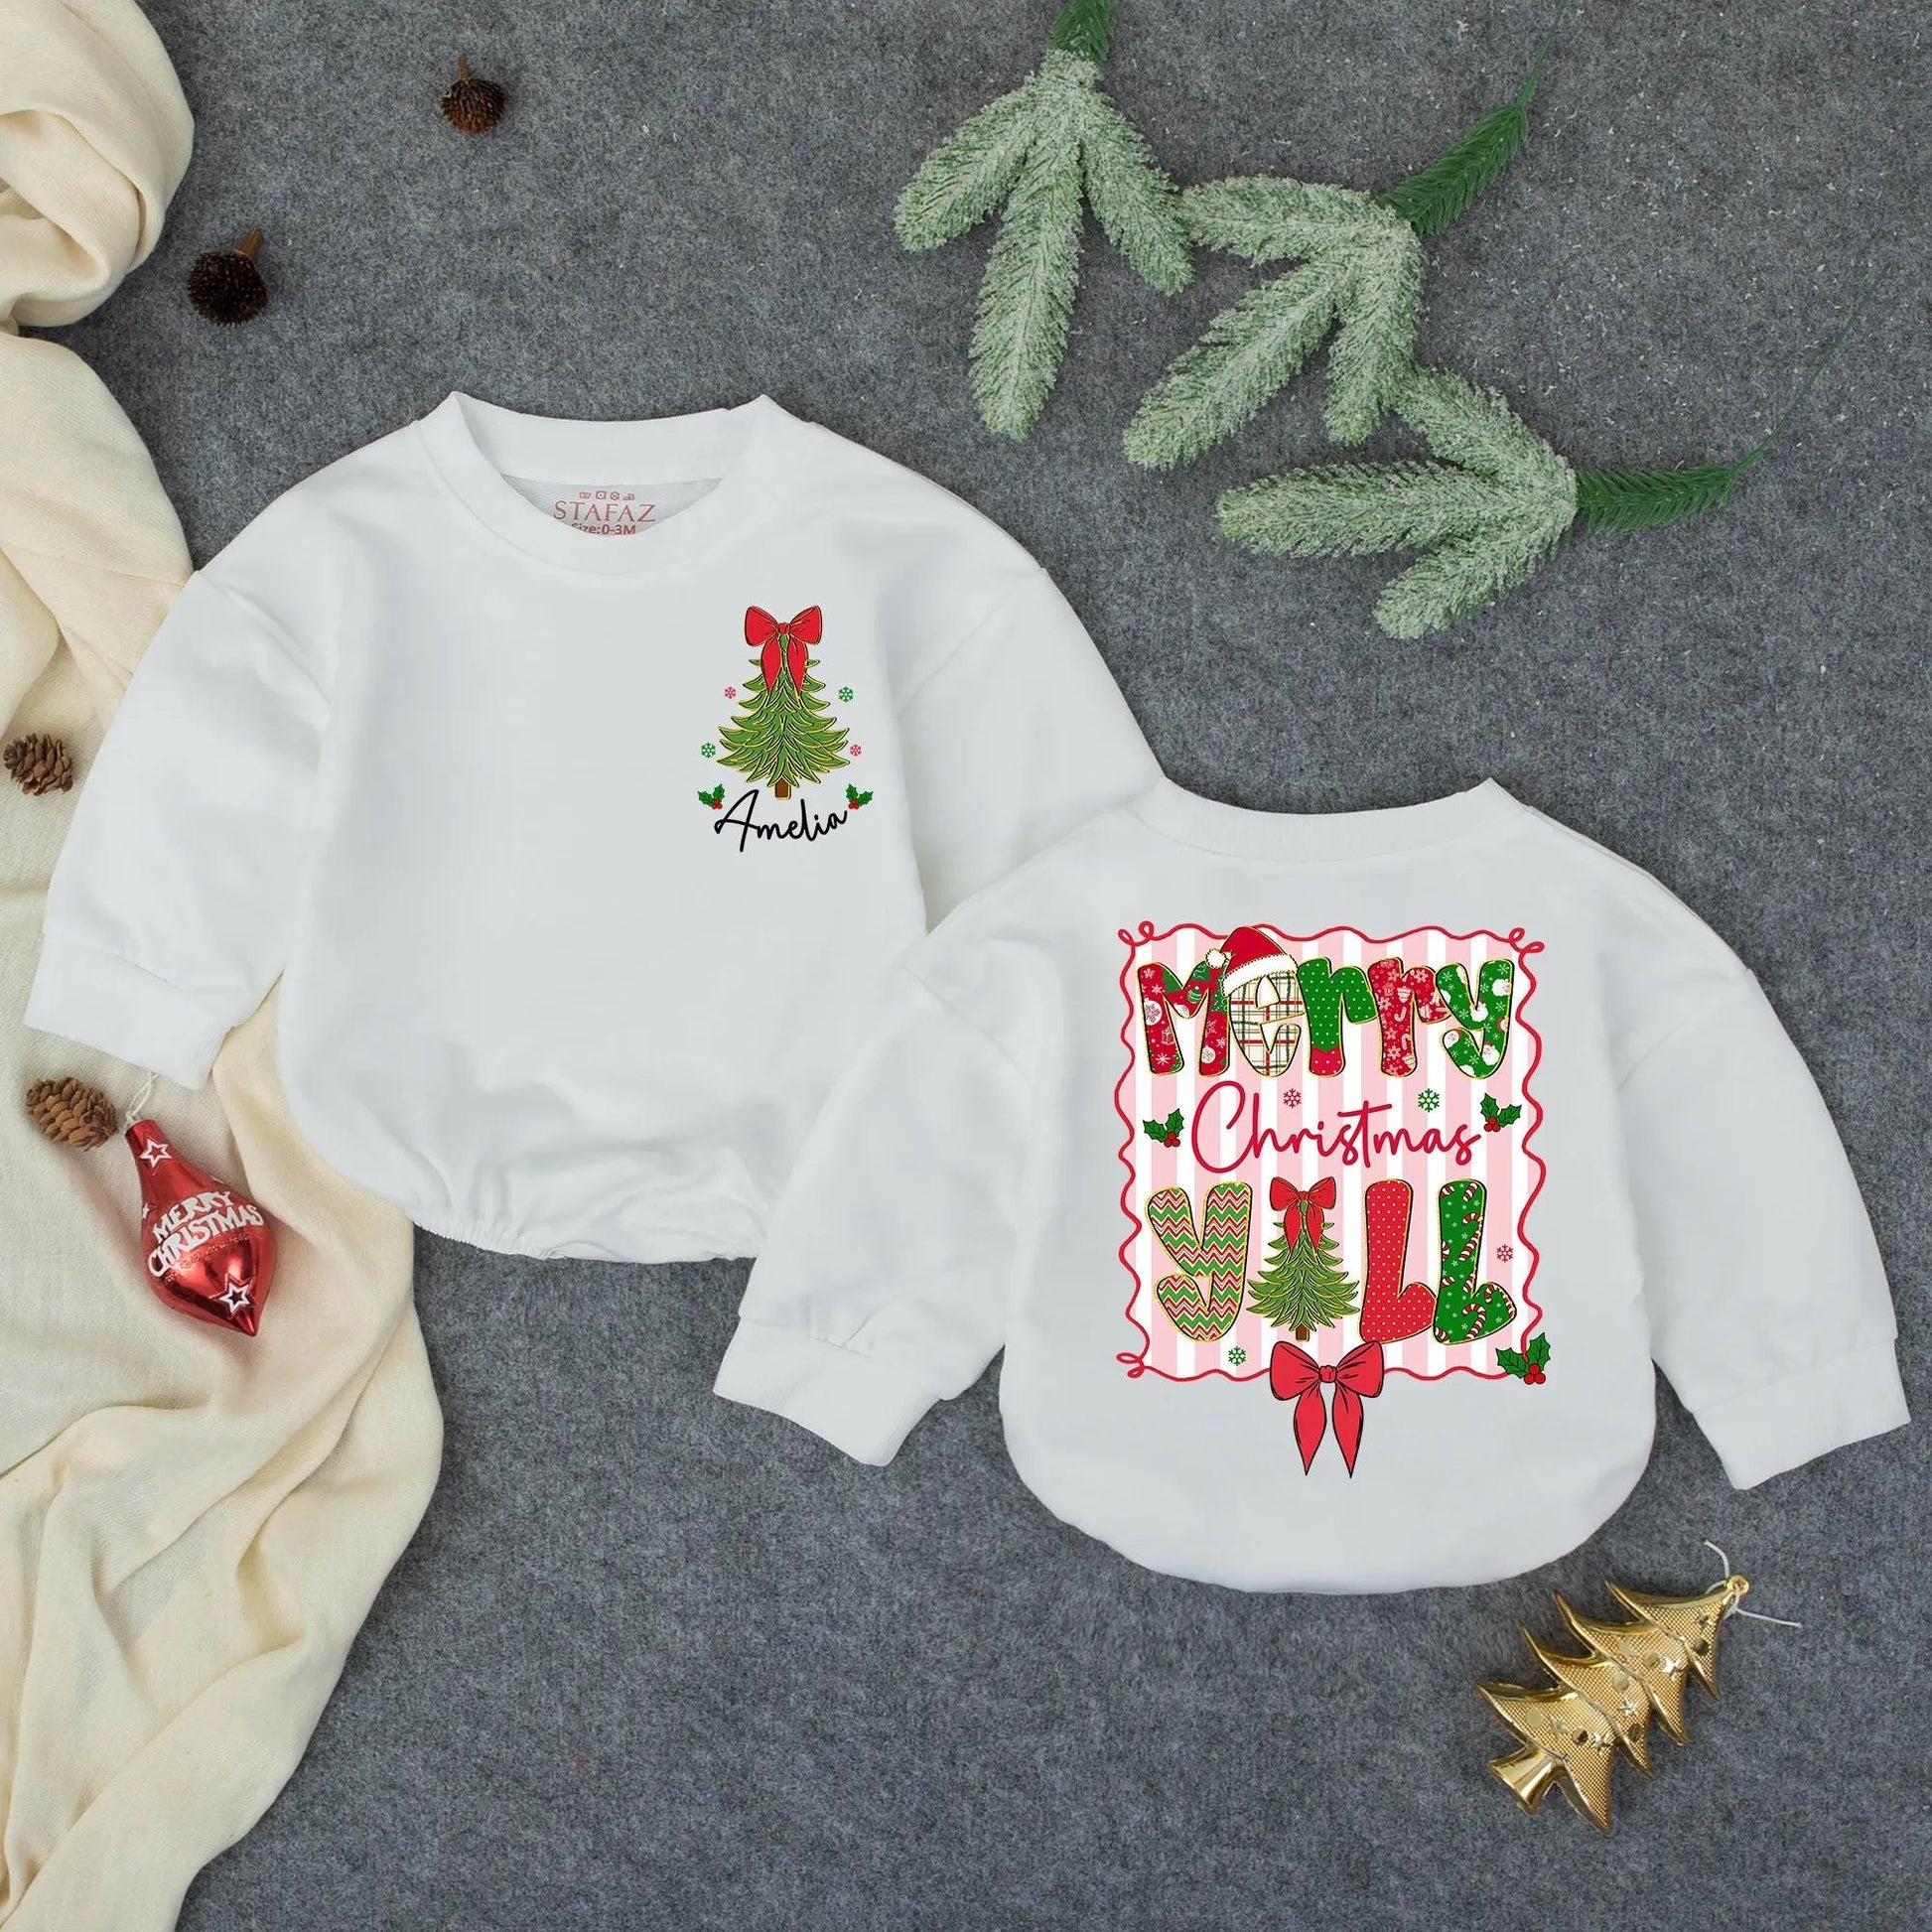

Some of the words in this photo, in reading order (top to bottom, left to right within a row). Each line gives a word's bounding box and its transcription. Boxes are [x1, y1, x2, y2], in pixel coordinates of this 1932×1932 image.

[553, 499, 656, 522] STAFAZ
[714, 789, 848, 852] Amelia
[1137, 956, 1515, 1079] Merry
[1191, 1080, 1481, 1173] Christmas
[149, 1204, 264, 1278] CHRISTMAS
[153, 1191, 233, 1244] MERRY
